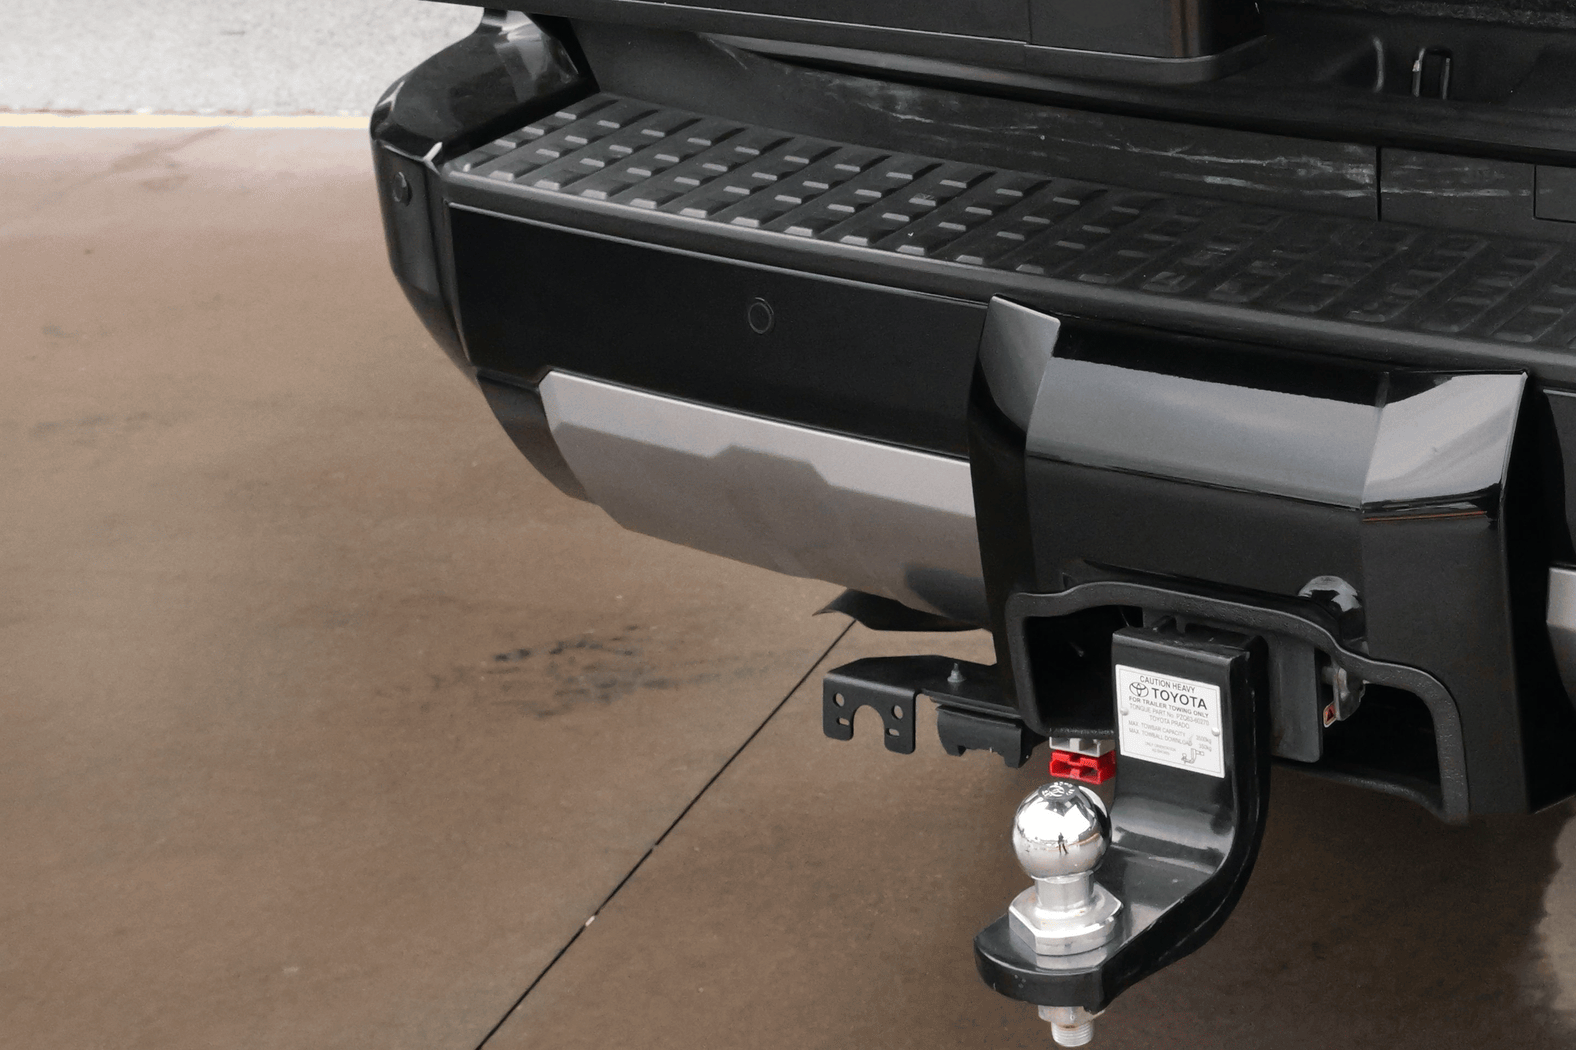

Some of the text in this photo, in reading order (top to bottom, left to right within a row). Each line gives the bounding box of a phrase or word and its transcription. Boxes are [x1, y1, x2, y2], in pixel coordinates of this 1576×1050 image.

[1139, 675, 1196, 694] CAUTION HEAVY
[1151, 687, 1208, 710] TOYOTA
[1129, 703, 1152, 714] TONGUE
[1152, 708, 1166, 716] PART
[1142, 699, 1167, 709] TRAILER
[1168, 705, 1192, 715] TOWING
[1193, 710, 1209, 718] ONLY
[1141, 722, 1162, 732] TOWBAR
[1162, 727, 1186, 737] CAPACITY
[1149, 715, 1190, 730] TOYOTA PRADO
[1142, 730, 1164, 741] TOWBALL
